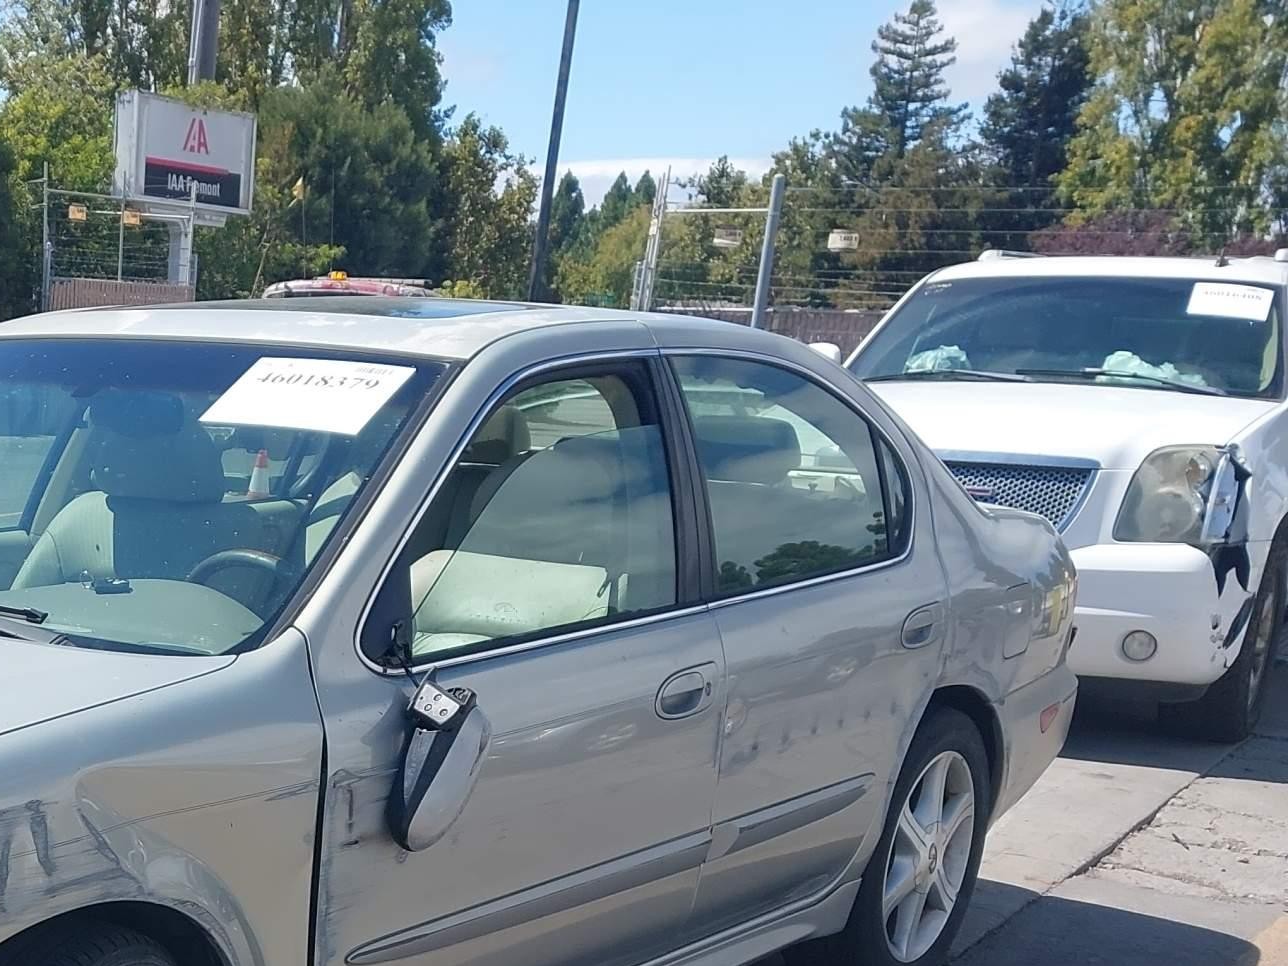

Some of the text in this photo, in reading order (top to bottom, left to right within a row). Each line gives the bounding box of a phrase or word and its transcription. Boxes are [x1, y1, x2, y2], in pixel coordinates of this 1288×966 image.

[167, 172, 221, 197] IAA Femont
[257, 371, 381, 390] 46018379
